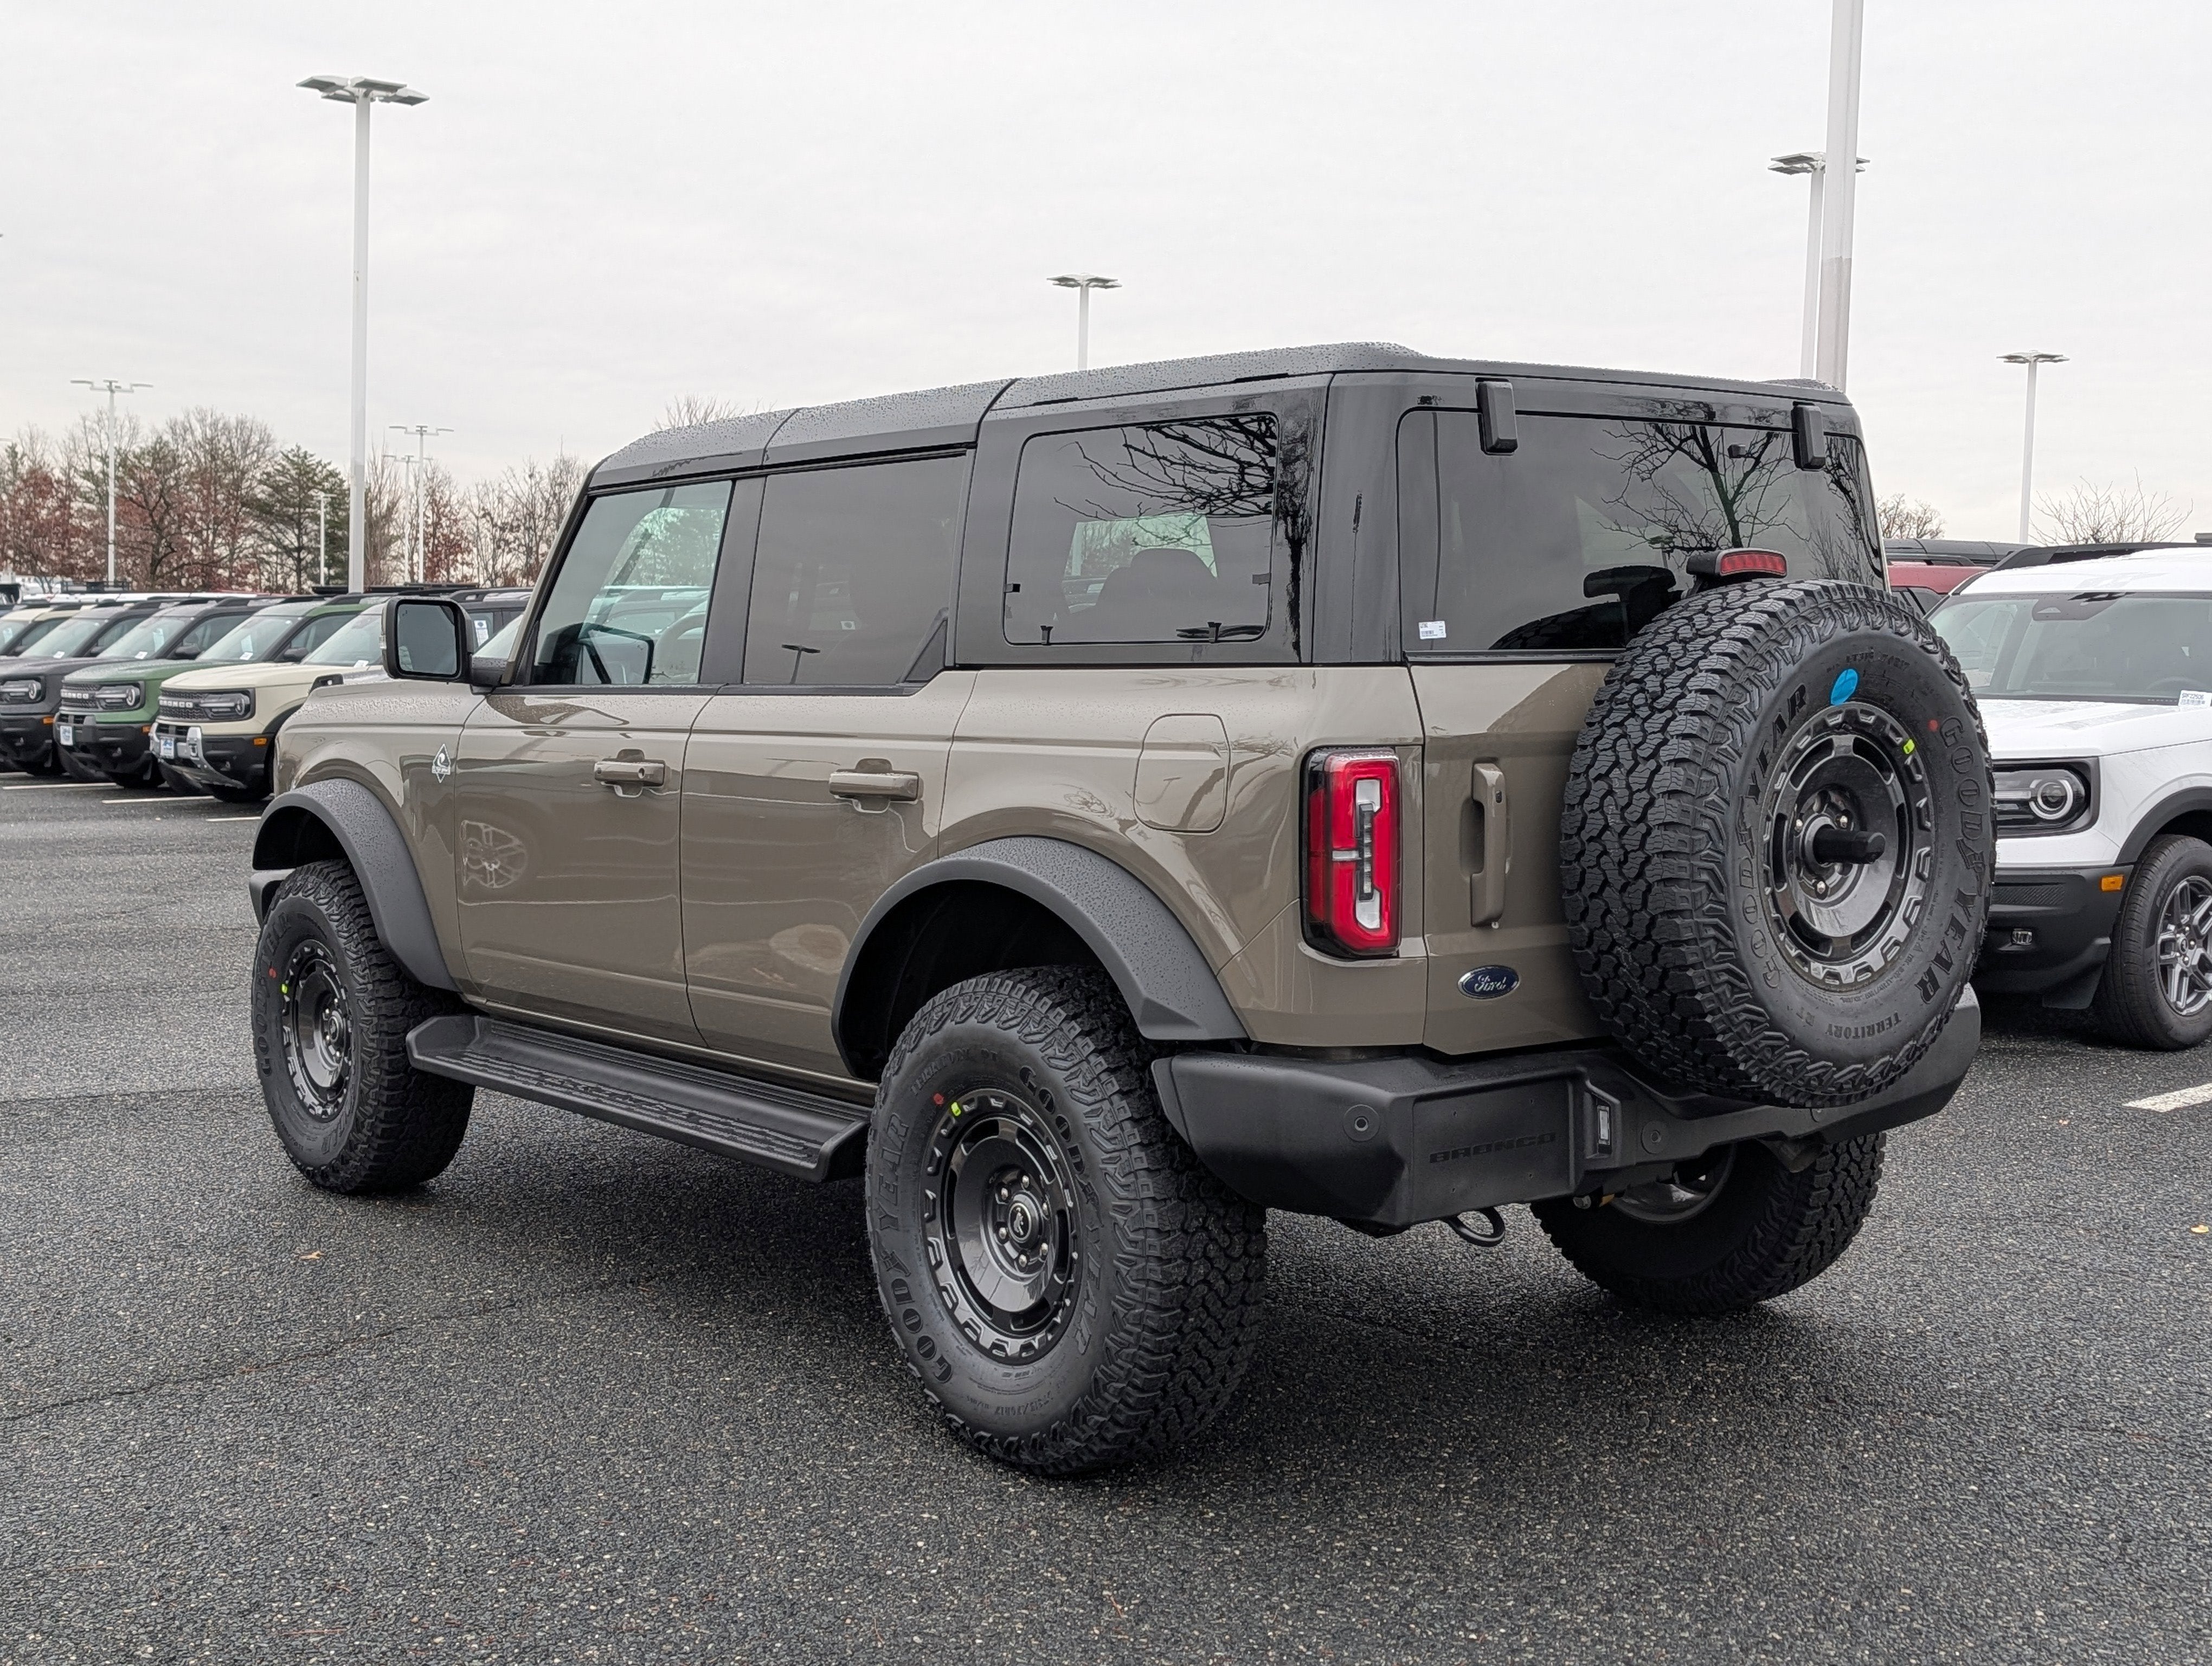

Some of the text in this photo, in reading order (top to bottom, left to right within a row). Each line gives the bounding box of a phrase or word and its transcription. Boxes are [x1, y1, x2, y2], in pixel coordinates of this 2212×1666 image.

[1825, 1011, 1902, 1040] TERRITORY
[1429, 1132, 1557, 1164] BRONCO
[876, 1113, 953, 1383] GOODYEAR
